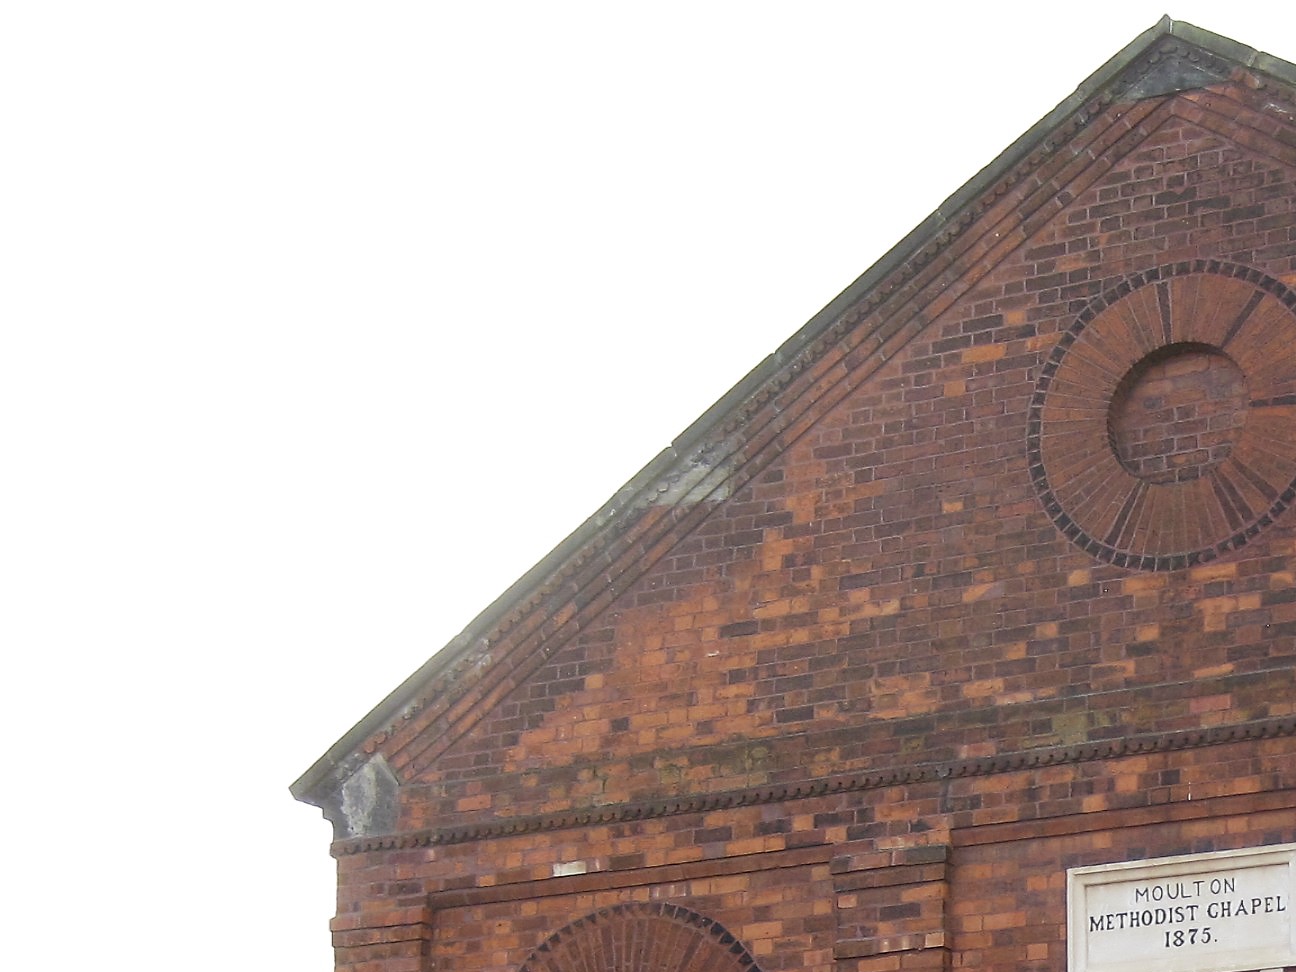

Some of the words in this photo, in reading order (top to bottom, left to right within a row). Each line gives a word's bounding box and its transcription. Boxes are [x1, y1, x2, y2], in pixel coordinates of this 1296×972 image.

[1135, 877, 1235, 903] MOULTON
[1089, 905, 1199, 932] METHODIST
[1207, 896, 1286, 919] CHAPEL
[1164, 927, 1218, 948] 1875.
